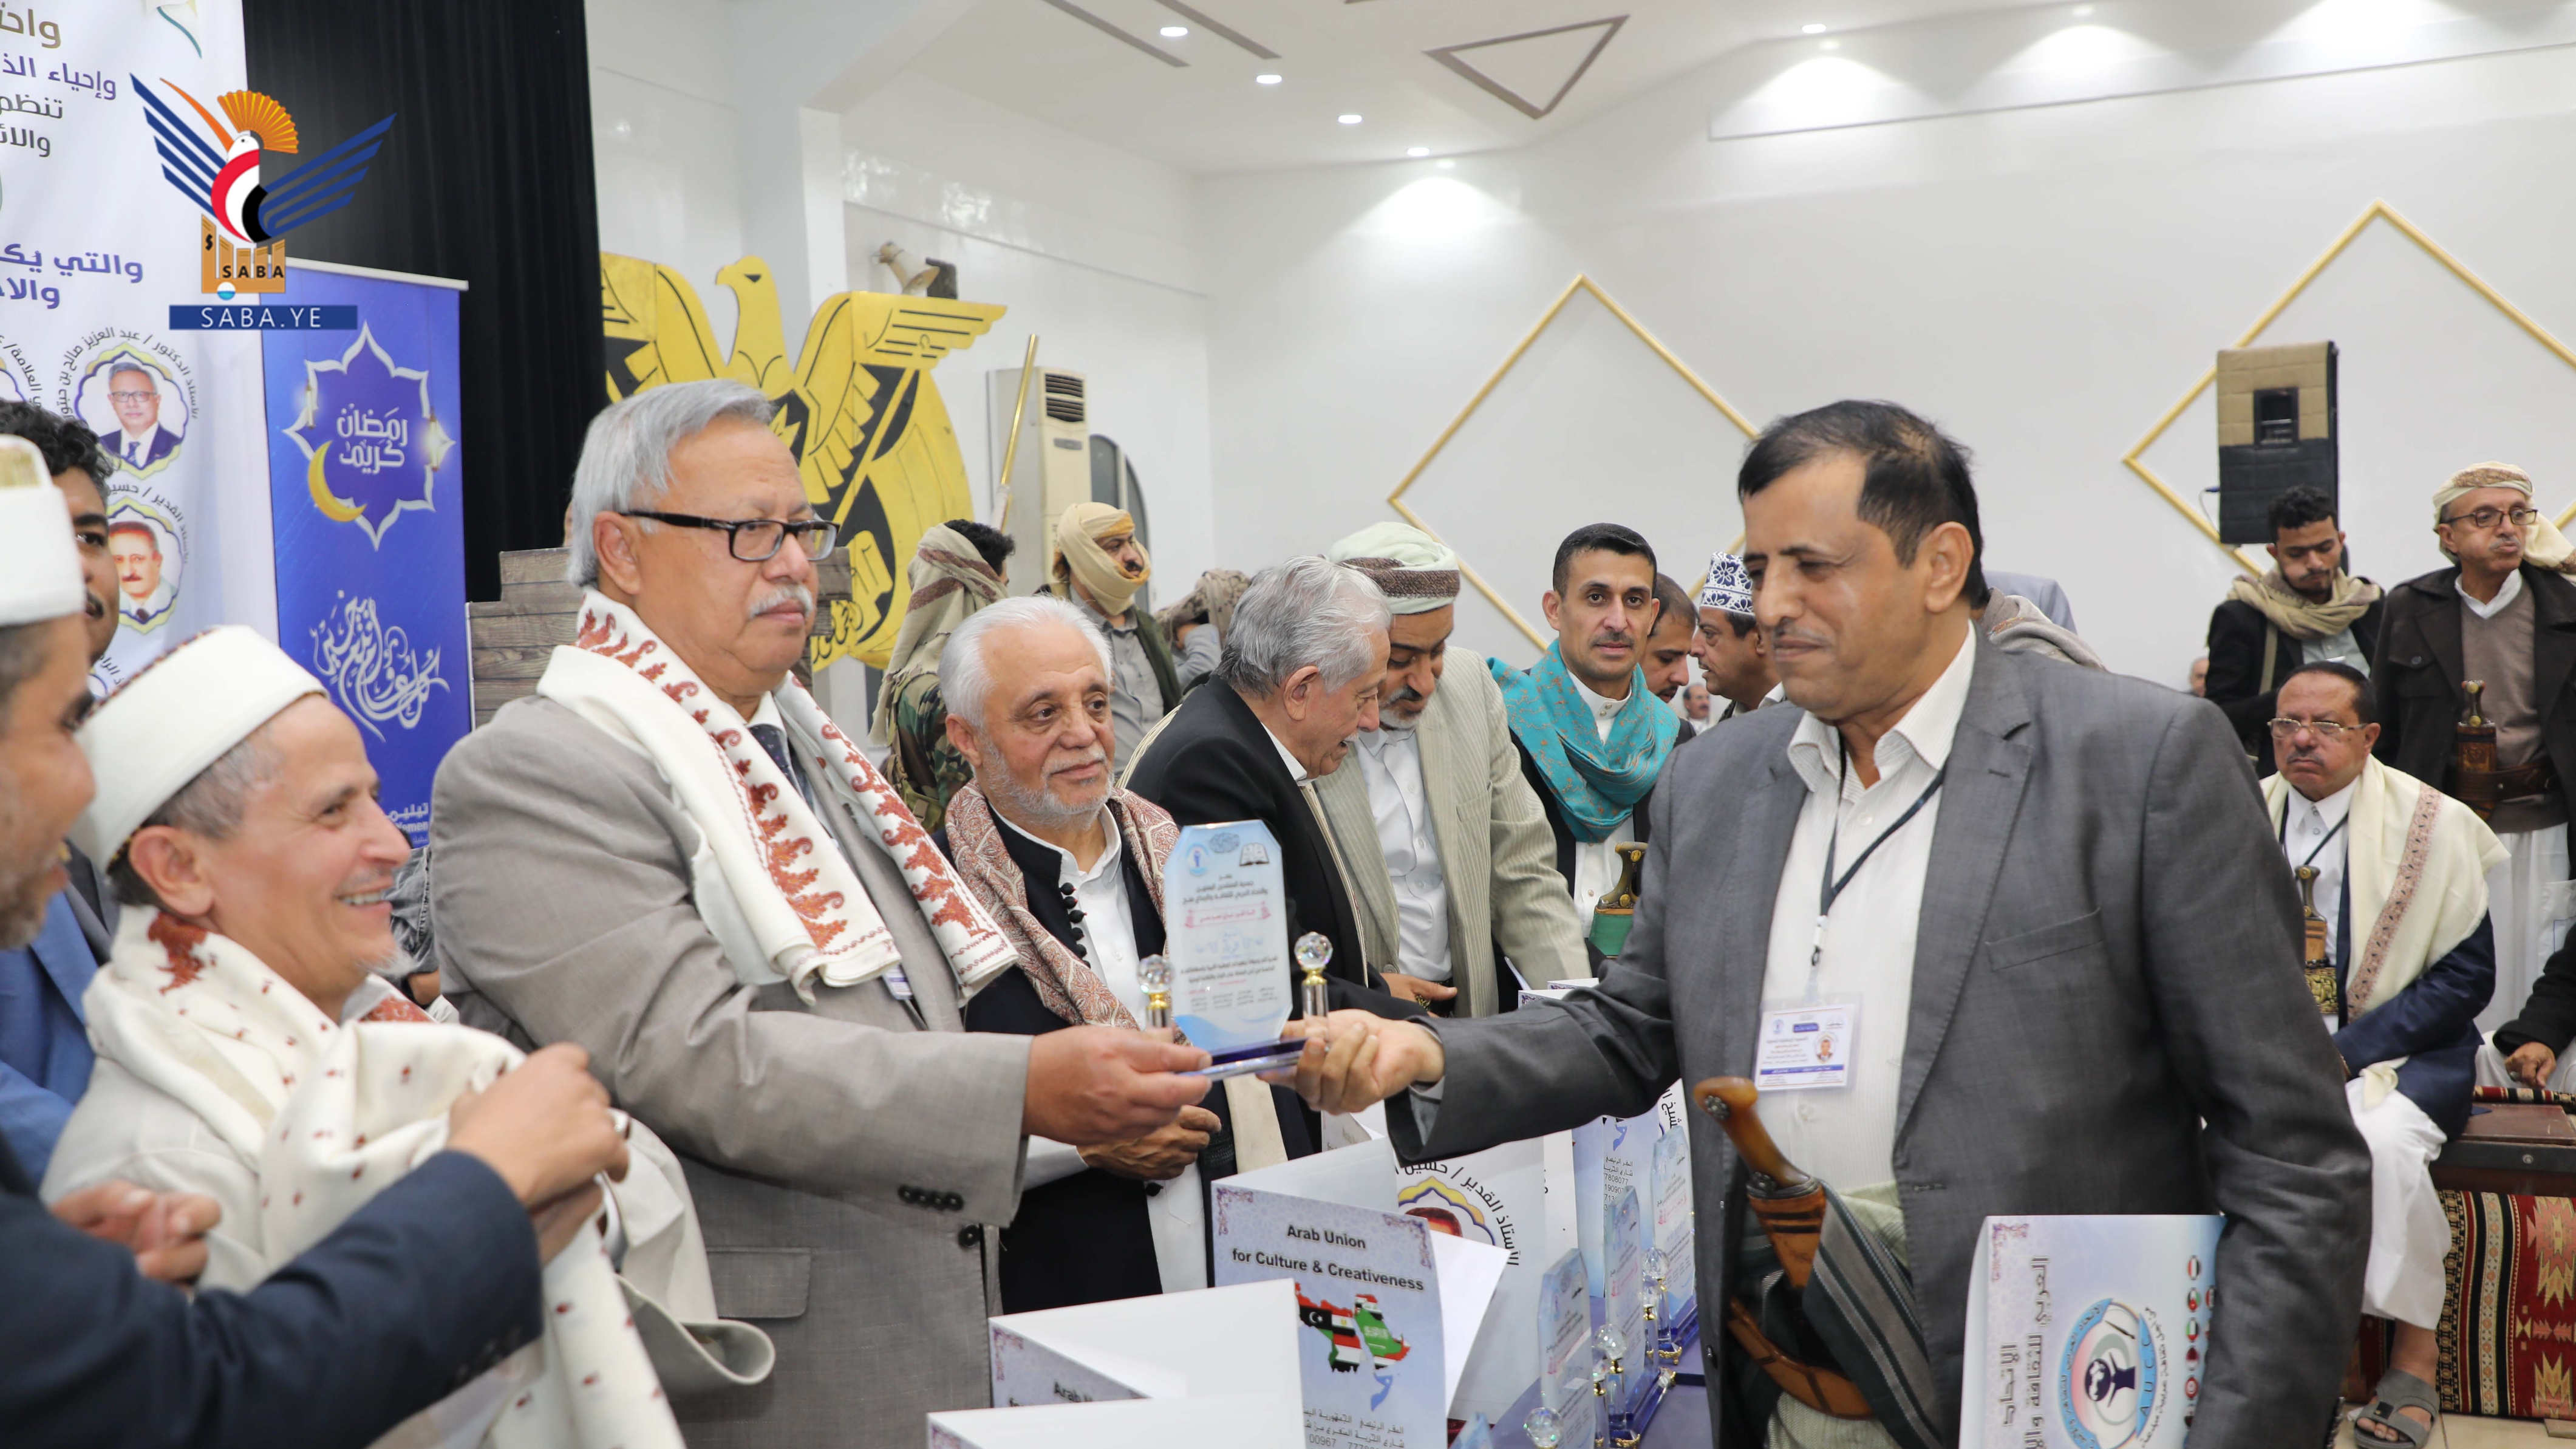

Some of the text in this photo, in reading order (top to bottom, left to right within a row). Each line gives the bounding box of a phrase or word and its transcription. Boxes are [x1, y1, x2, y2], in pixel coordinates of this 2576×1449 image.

[2, 53, 117, 101] وإحياء الذ
[54, 252, 143, 283] والتي
[81, 327, 115, 350] العزيز
[120, 330, 140, 341] عبد
[11, 348, 43, 391] العلامة
[63, 345, 83, 371] صالح
[152, 342, 191, 375] الدكتور
[60, 371, 72, 386] بن
[111, 484, 138, 495] حسي
[151, 494, 184, 522] القدير
[1460, 1177, 1504, 1212] القدير
[1287, 1224, 1366, 1249] Arab Union
[1233, 1247, 1424, 1290] for Culture & Creativeness
[2029, 1255, 2052, 1327] العربي
[2026, 1332, 2043, 1408] للثقافة
[1309, 1433, 1337, 1447] 00967
